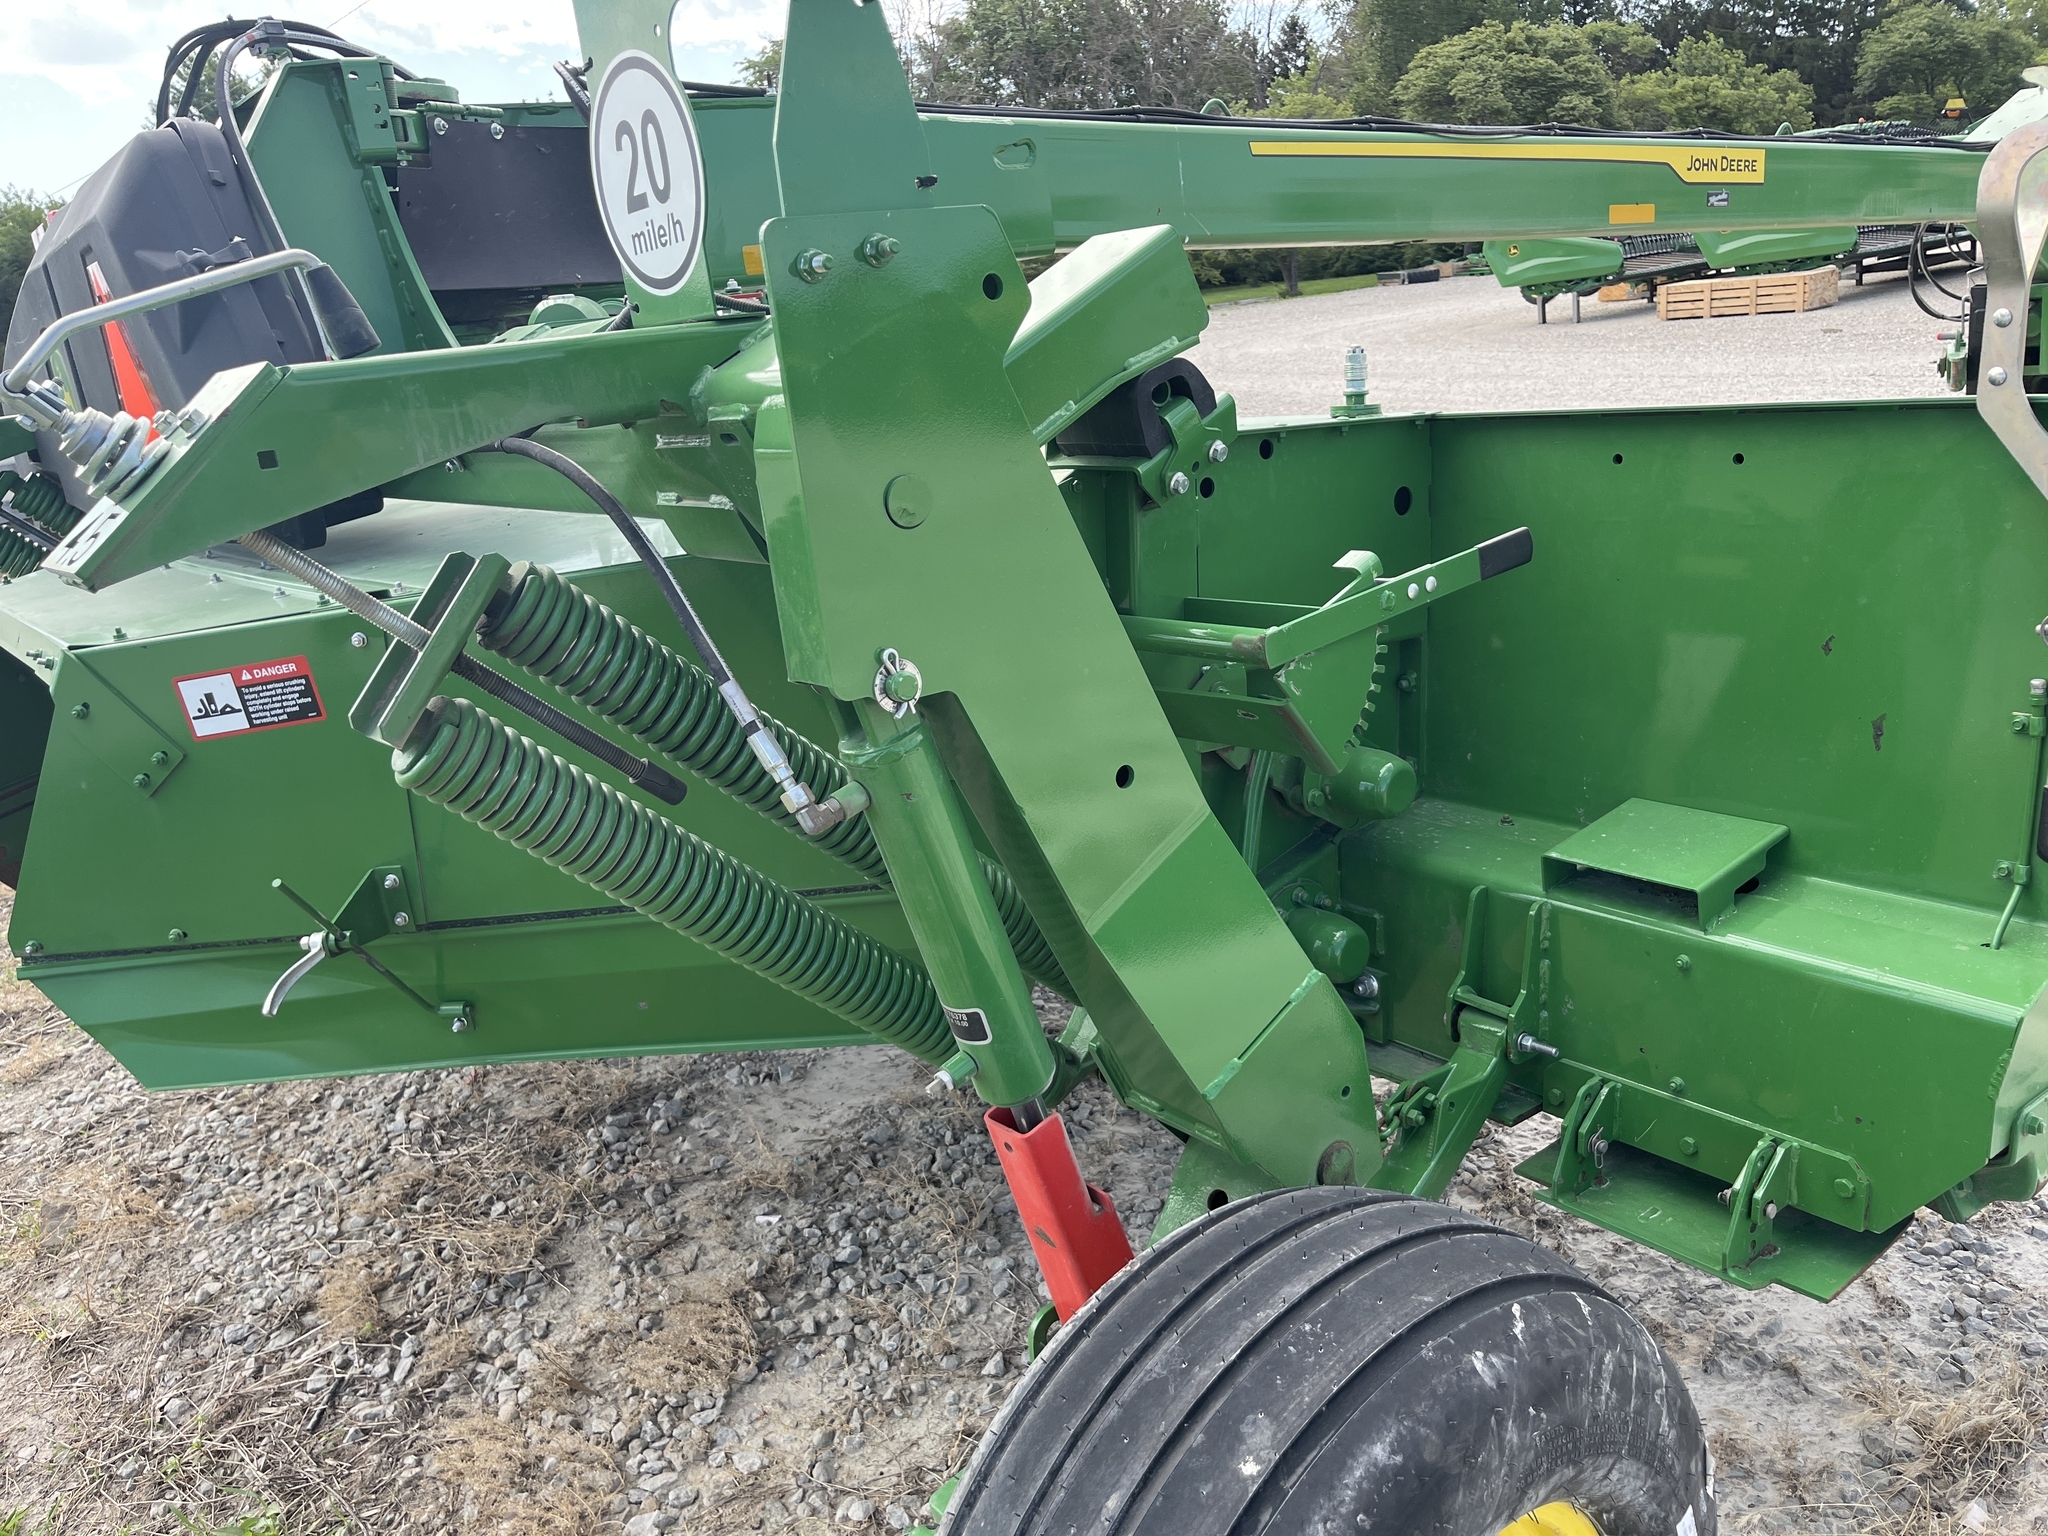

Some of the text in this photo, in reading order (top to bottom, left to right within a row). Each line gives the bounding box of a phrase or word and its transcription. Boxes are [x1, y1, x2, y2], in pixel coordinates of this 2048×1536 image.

[614, 108, 671, 215] 20
[1687, 155, 1757, 172] JOHN DEERE
[631, 212, 686, 256] mile/h
[253, 663, 297, 678] DANGER
[246, 698, 272, 706] completely
[253, 716, 278, 725] harvesting
